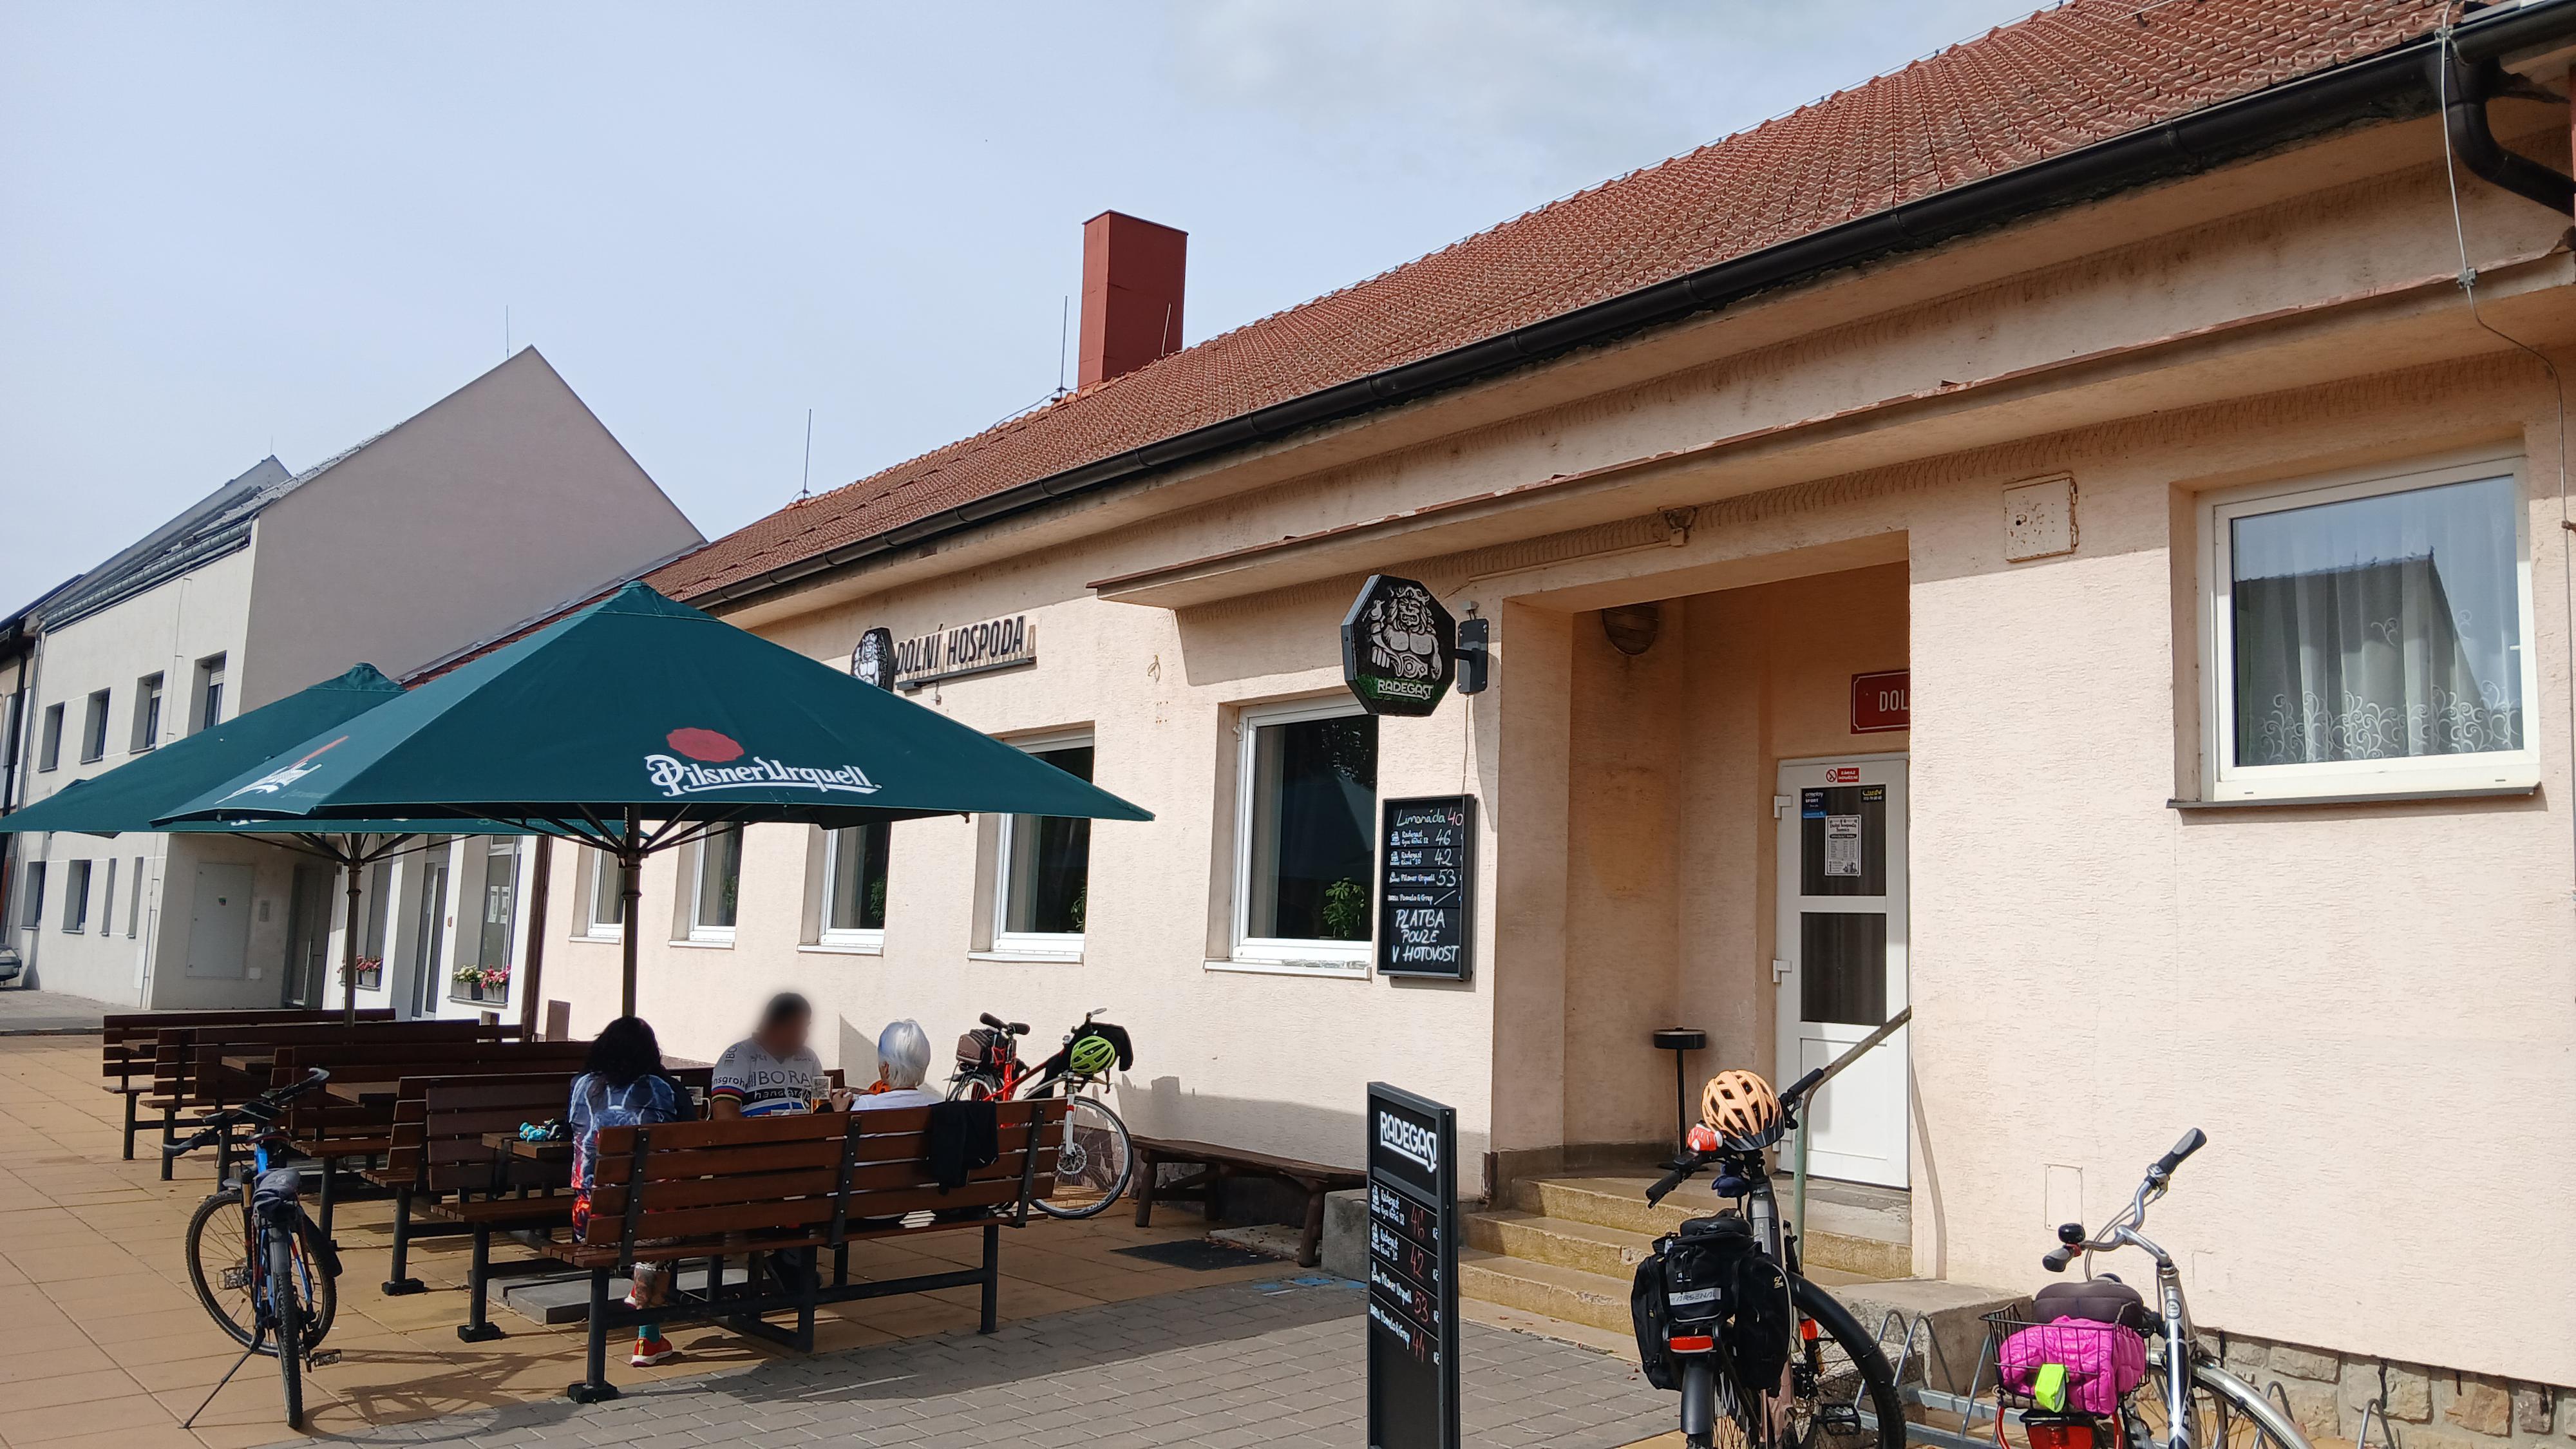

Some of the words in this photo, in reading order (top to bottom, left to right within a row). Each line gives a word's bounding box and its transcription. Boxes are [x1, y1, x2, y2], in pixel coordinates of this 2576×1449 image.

[896, 623, 943, 674] DOLNÍ
[947, 615, 1026, 665] HOSPODA
[1377, 679, 1434, 700] RADEGAST
[644, 754, 764, 797] Pilsner
[753, 757, 873, 793] Urquell
[1396, 808, 1446, 826] Limonáda
[1447, 806, 1463, 826] 40
[1435, 828, 1452, 846] 46
[1434, 848, 1452, 866] 42
[1436, 868, 1456, 887] 53
[1395, 909, 1445, 929] PLATBA
[1401, 929, 1440, 943] POUZE
[1392, 944, 1399, 963] V
[1402, 945, 1460, 963] HOTOVOST
[759, 1070, 810, 1086] BORA
[1411, 1205, 1425, 1240] 46
[1410, 1245, 1424, 1280] 42
[1414, 1291, 1429, 1323] 53
[1412, 1327, 1425, 1363] 44
